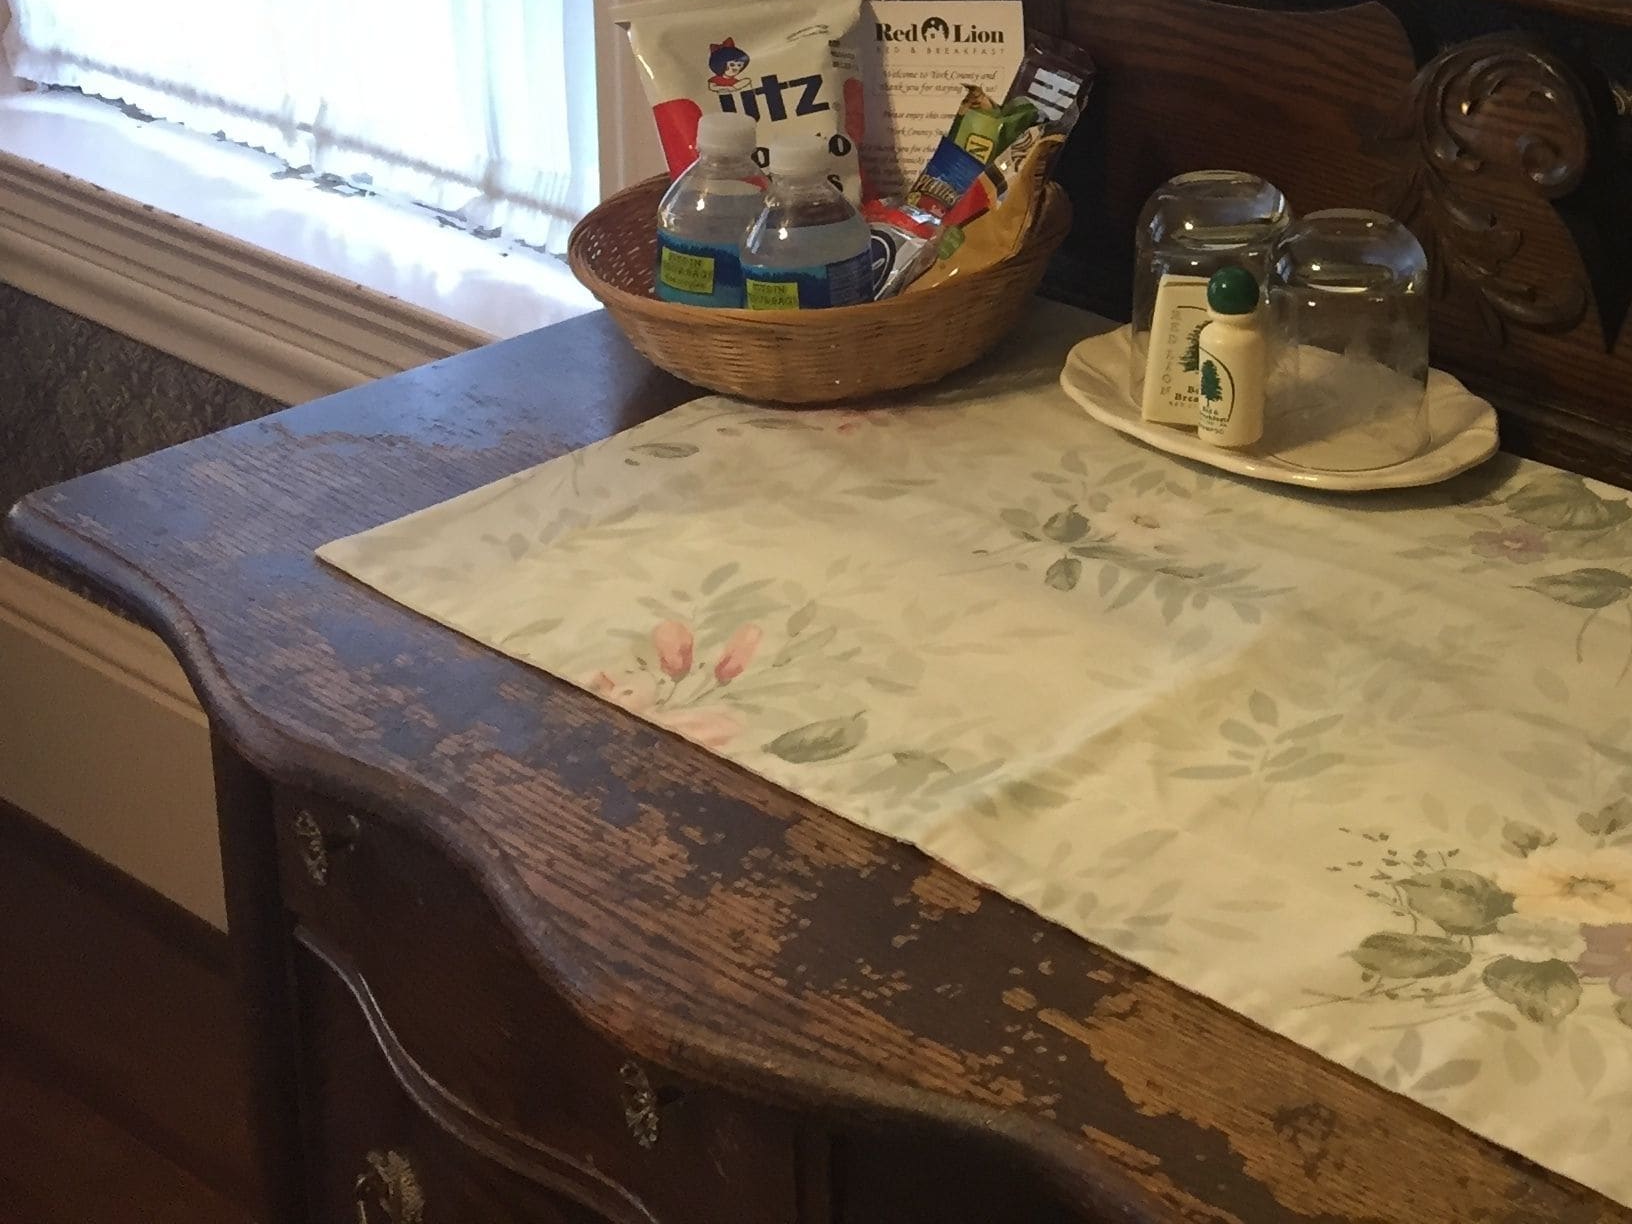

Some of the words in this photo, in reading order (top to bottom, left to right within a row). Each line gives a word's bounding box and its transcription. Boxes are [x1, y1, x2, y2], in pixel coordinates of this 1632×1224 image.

[875, 23, 919, 42] Red
[953, 24, 1005, 44] Lion
[926, 47, 1005, 55] BREAKFAST
